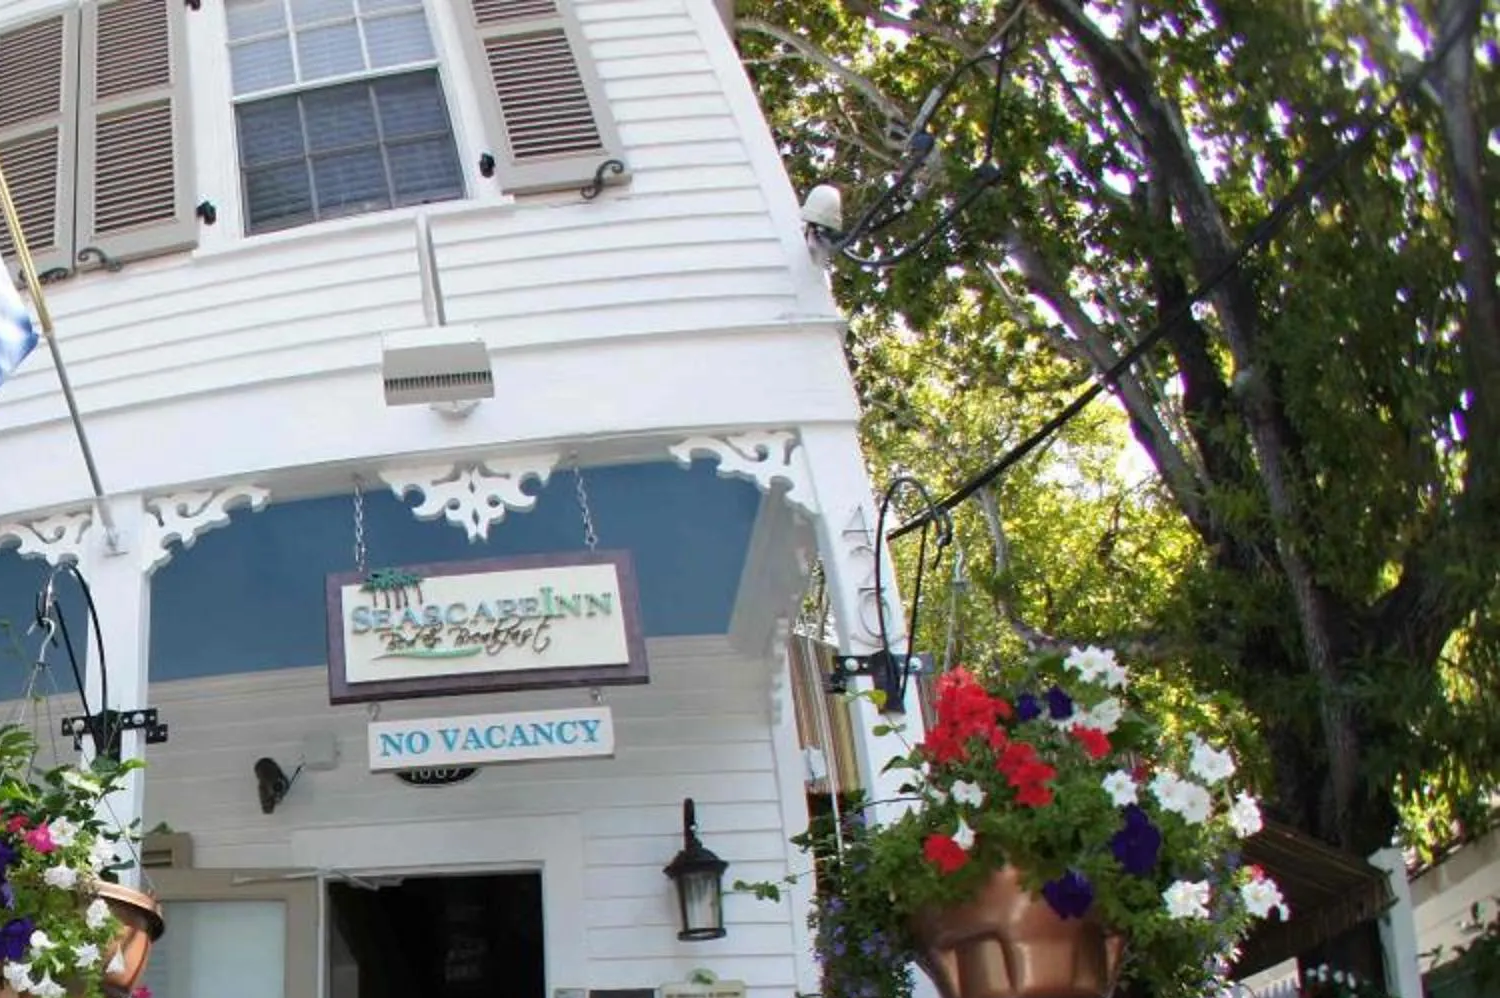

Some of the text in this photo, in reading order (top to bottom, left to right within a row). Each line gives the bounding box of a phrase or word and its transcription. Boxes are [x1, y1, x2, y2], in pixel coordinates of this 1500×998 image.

[447, 614, 554, 656] Breakfast
[379, 719, 601, 757] NO VACANCY
